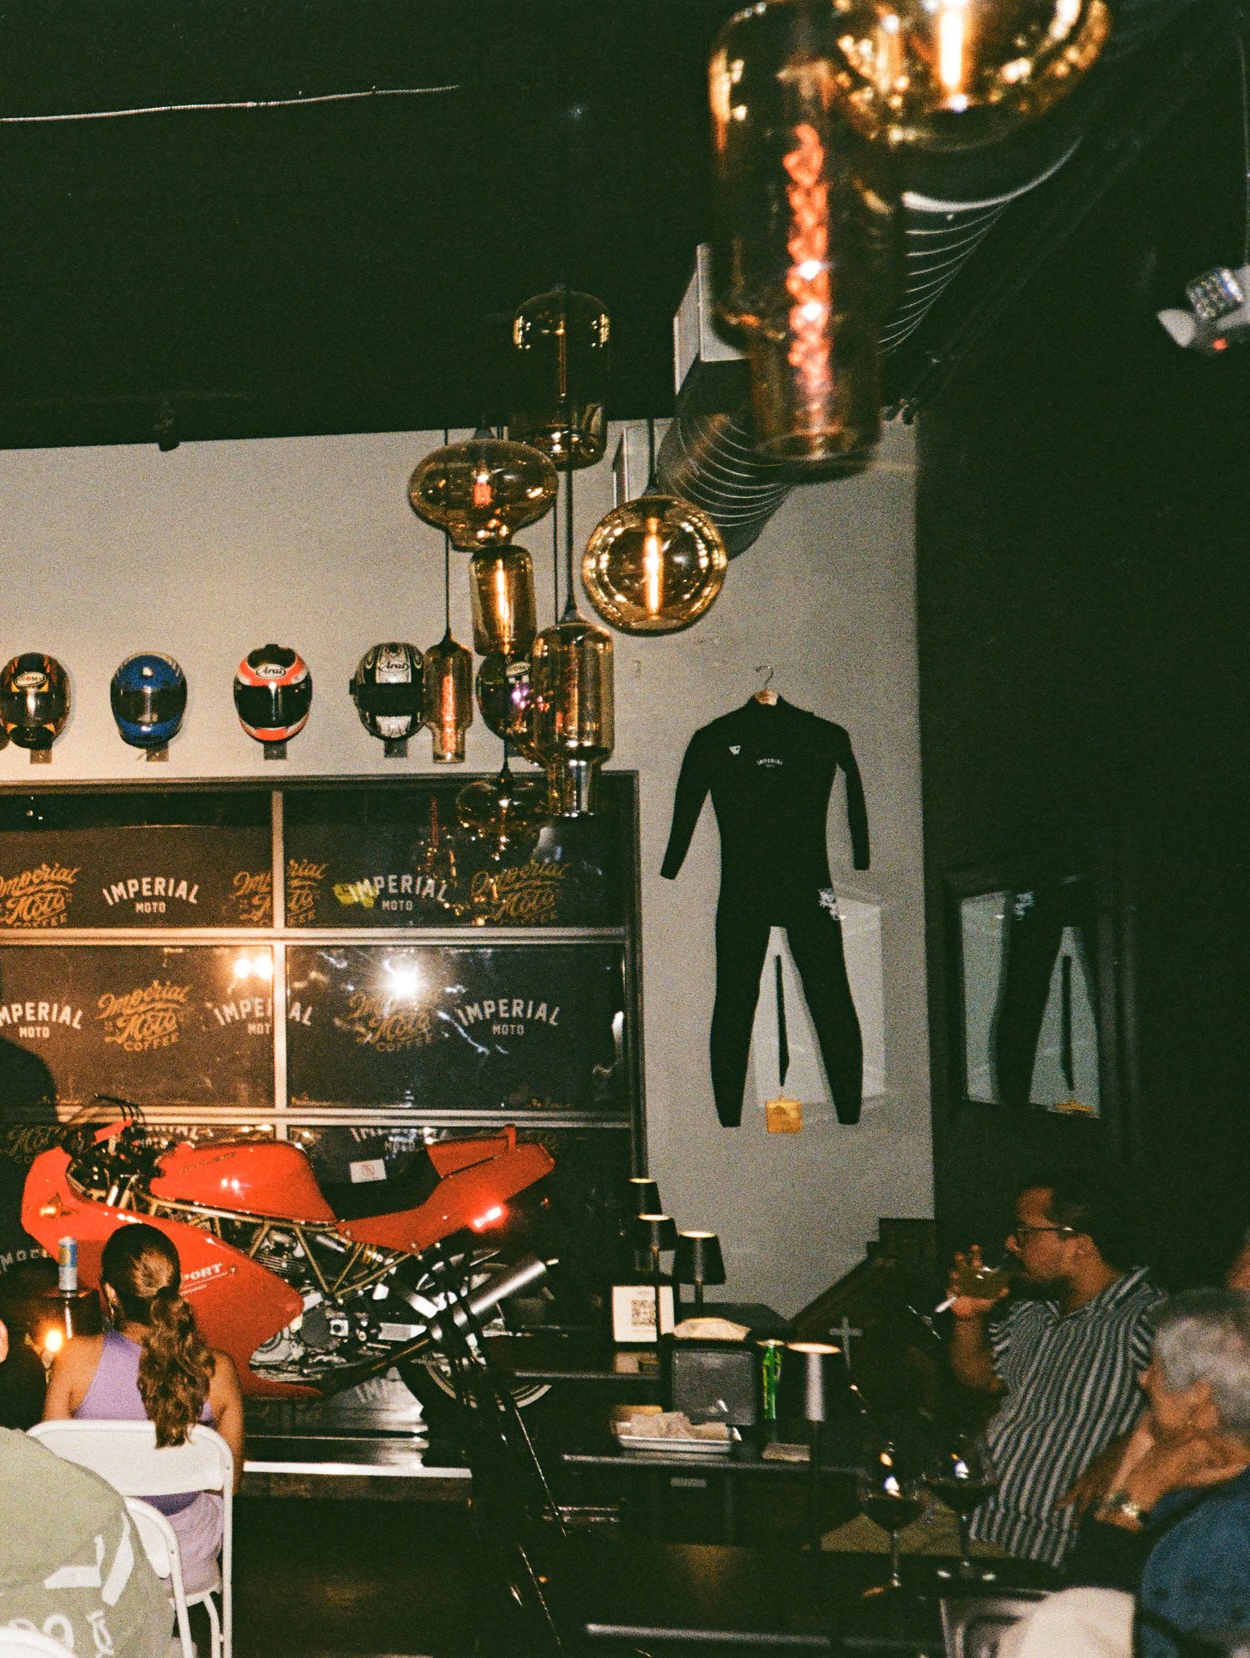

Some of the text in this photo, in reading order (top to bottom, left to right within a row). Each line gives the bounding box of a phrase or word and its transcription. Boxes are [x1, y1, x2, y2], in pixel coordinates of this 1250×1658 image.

[102, 876, 199, 906] IMPERIAL
[347, 874, 448, 903] IMPERIAL
[135, 902, 166, 914] MOTO
[381, 899, 413, 911] MOTO
[95, 980, 193, 1020] Imperial
[213, 997, 313, 1027] IMPEAL
[455, 998, 560, 1027] IMPERIAL
[19, 1026, 50, 1038] MOTO
[104, 1010, 178, 1045] Moto
[247, 1023, 271, 1035] MOT
[492, 1024, 525, 1036] MOTO
[124, 1032, 180, 1052] COFFEE
